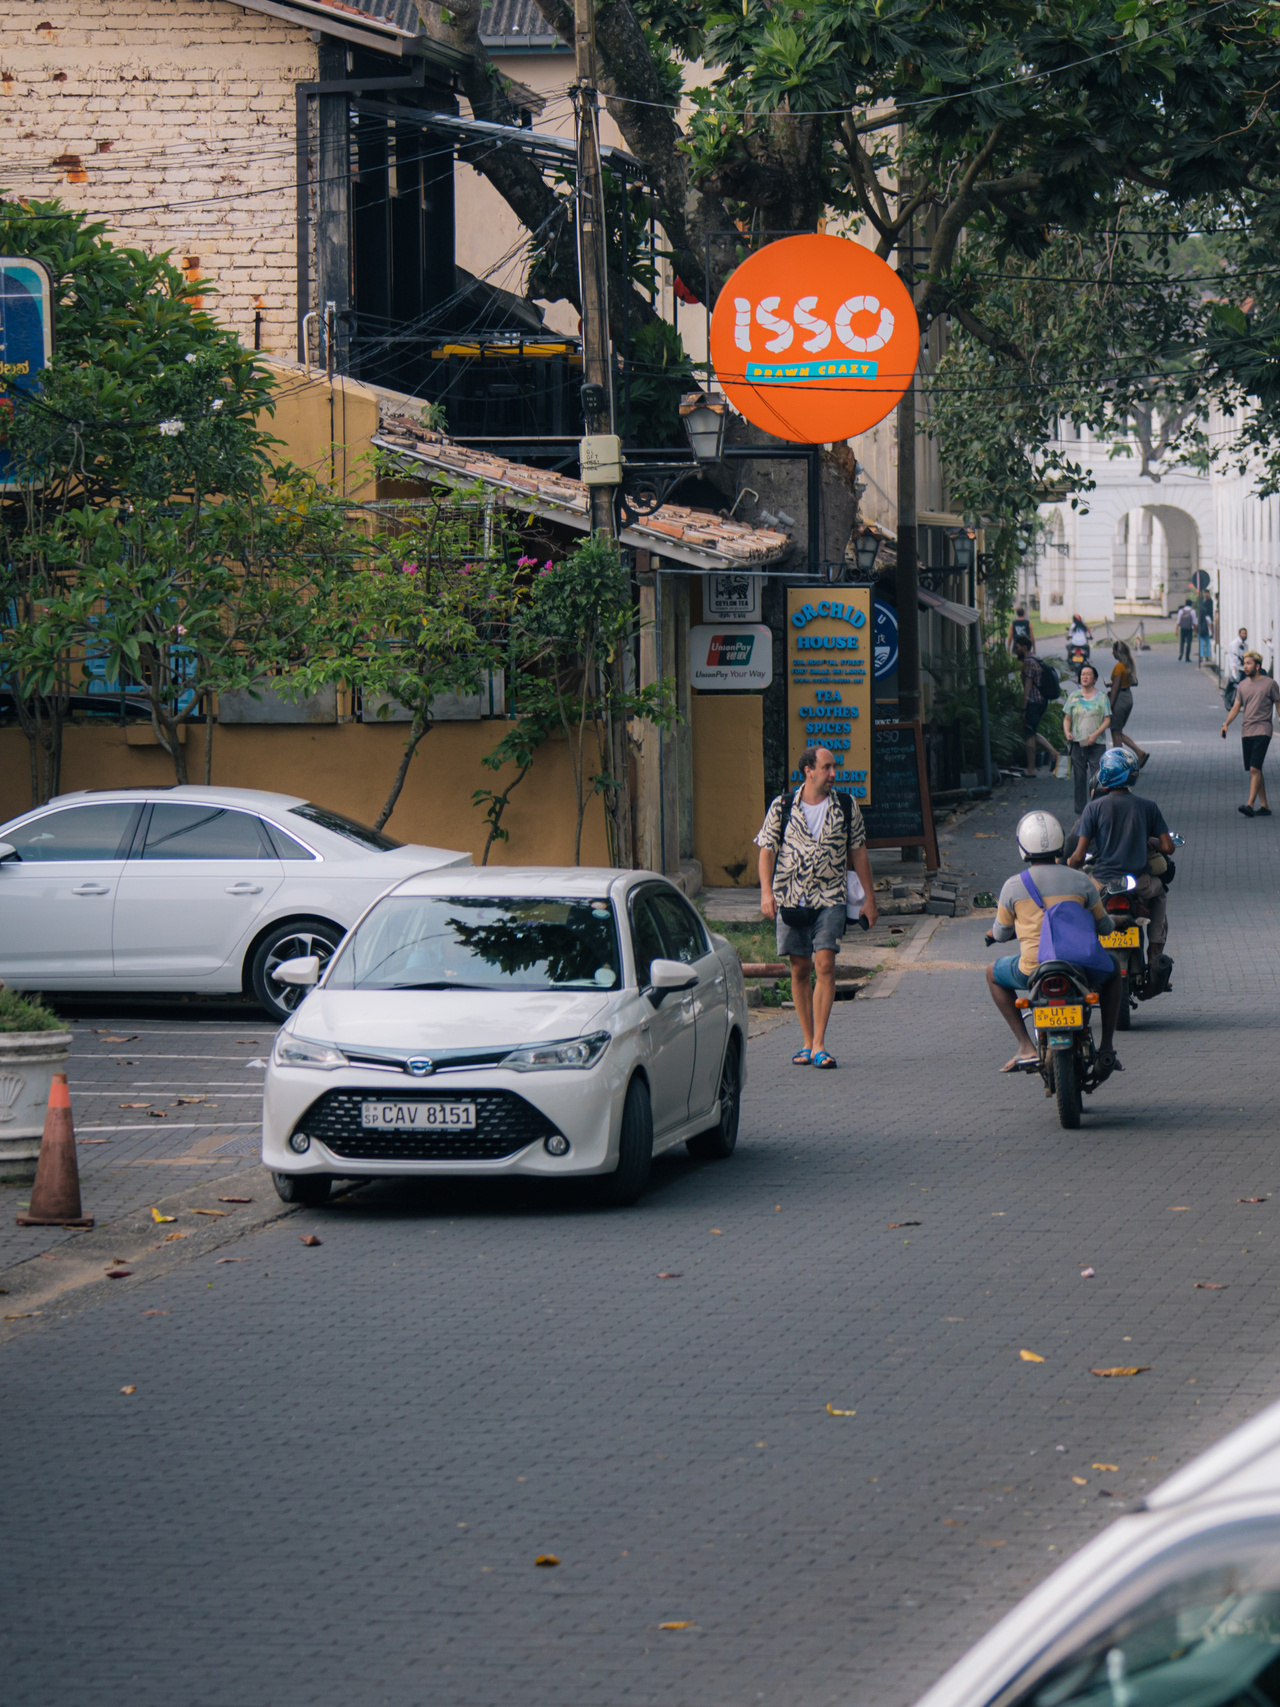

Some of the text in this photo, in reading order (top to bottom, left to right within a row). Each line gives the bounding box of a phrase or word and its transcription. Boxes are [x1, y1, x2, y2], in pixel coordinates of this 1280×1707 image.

[734, 295, 895, 354] ISSO
[753, 364, 870, 379] PRAWN CRAZY
[791, 600, 866, 628] ORCHID
[797, 635, 859, 649] HOUSE
[711, 642, 751, 655] UnionPay
[695, 670, 767, 680] UnionPay Your Way
[815, 690, 842, 701] TEA
[799, 706, 860, 718] CLOTHES
[806, 722, 851, 734] SPICES
[807, 738, 851, 749] BOOKS
[1112, 938, 1134, 946] 7241
[1051, 1008, 1066, 1016] UT
[1049, 1017, 1075, 1026] 5613
[364, 1106, 472, 1124] SP CAV 8151
